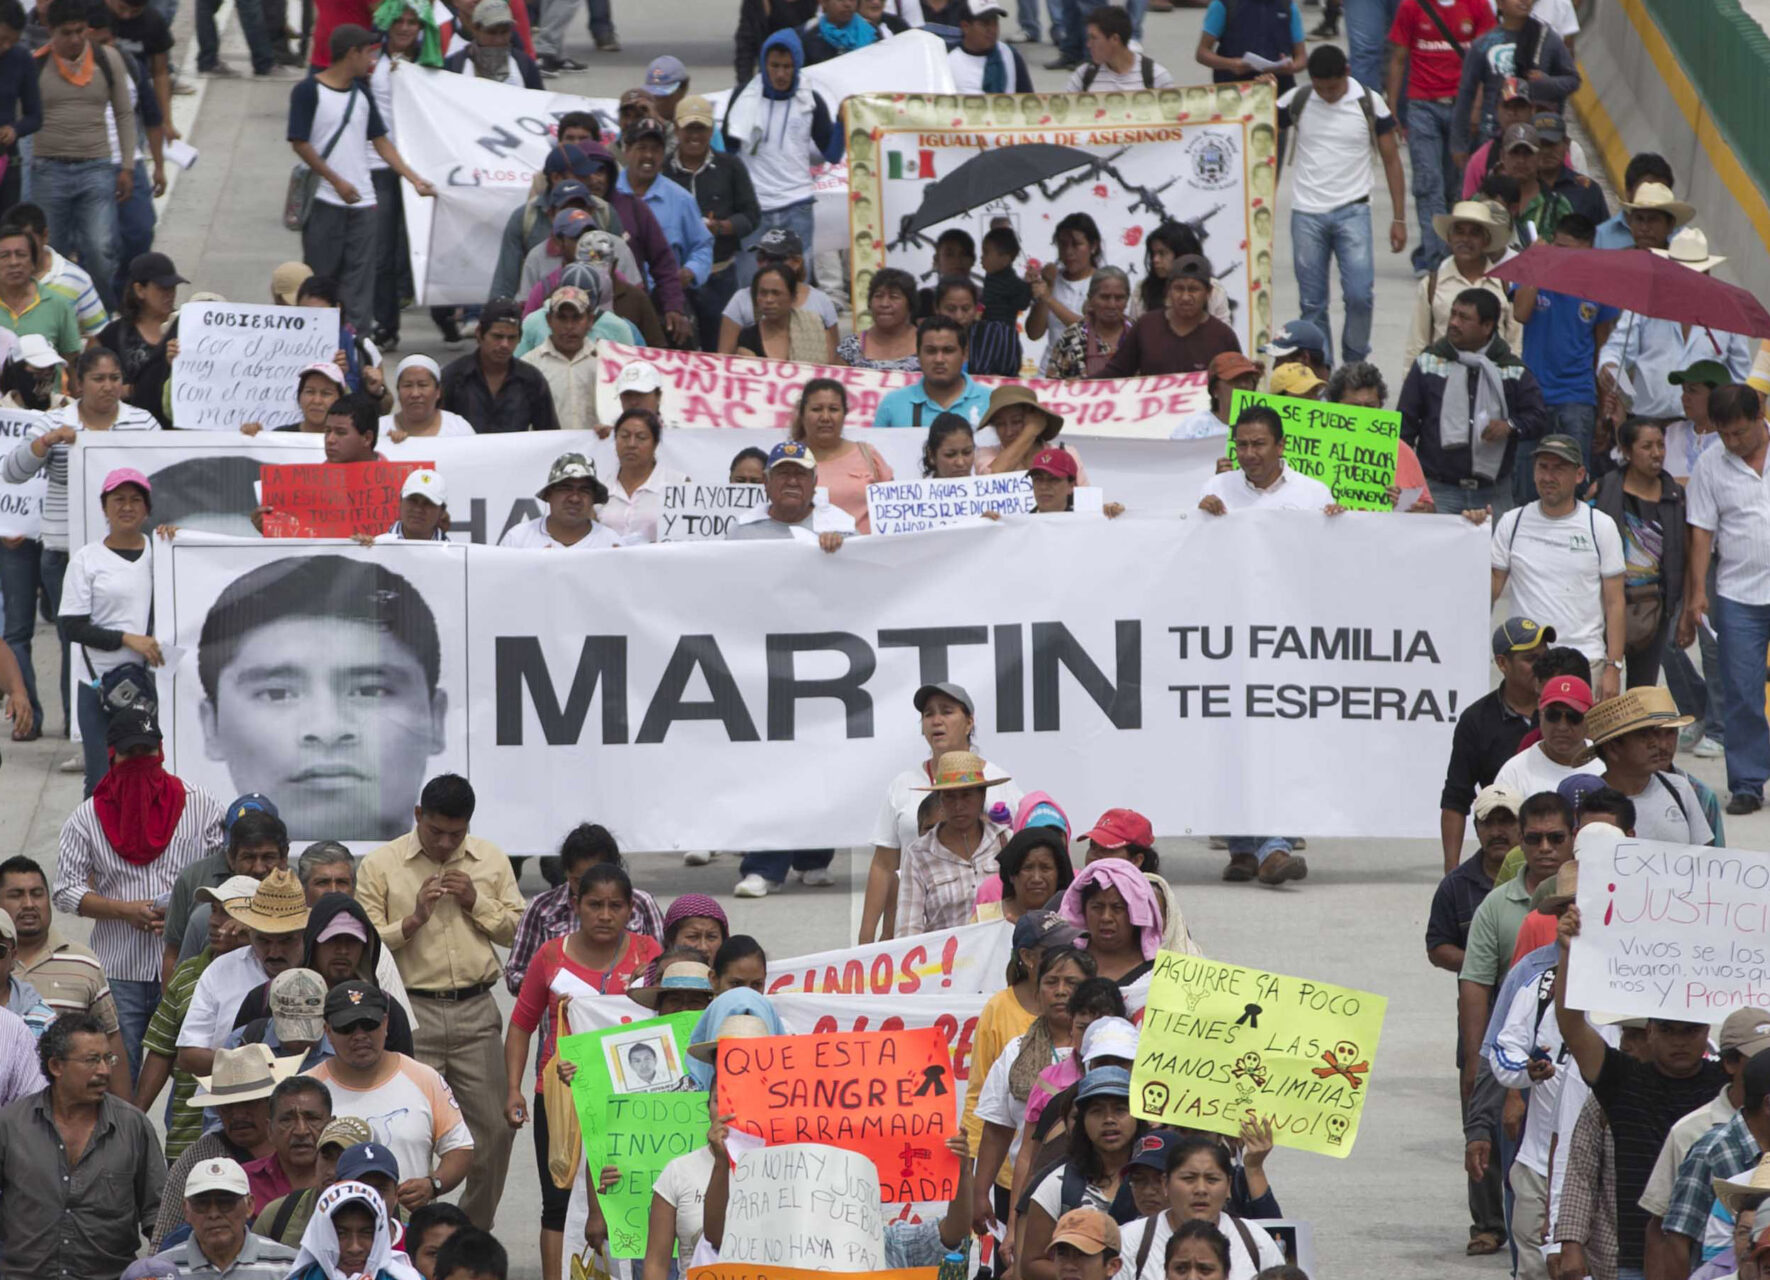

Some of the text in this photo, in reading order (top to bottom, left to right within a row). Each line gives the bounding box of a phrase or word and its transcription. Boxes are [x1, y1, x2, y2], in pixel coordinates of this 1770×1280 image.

[918, 134, 989, 148] IGUALA
[1055, 132, 1079, 146] DE
[1085, 128, 1183, 146] ASESINOS
[1307, 409, 1358, 433] PUEDE
[1365, 419, 1399, 439] SER
[869, 476, 1034, 502] PRIMERO AGUAS BLANCAS
[1333, 463, 1392, 487] PUEBLO
[663, 486, 686, 509] EN
[875, 501, 939, 520] DESPUES
[969, 495, 1035, 516] DICIEMBRE
[662, 513, 677, 537] Y
[1167, 625, 1441, 664] TU FAMILIA
[495, 618, 1142, 746] MARTIN
[1167, 684, 1459, 723] TE ESPERA!
[1153, 954, 1247, 997] AGUIRRE
[1298, 982, 1361, 1017] POCO
[1148, 1007, 1321, 1058] TIENES LAS
[723, 1037, 897, 1076] QUE ESTA
[1141, 1050, 1361, 1111] MANOS LIMPIAS
[746, 1110, 944, 1145] DERRAMADA
[778, 1185, 802, 1209] EL
[790, 1233, 835, 1260] HAYA
